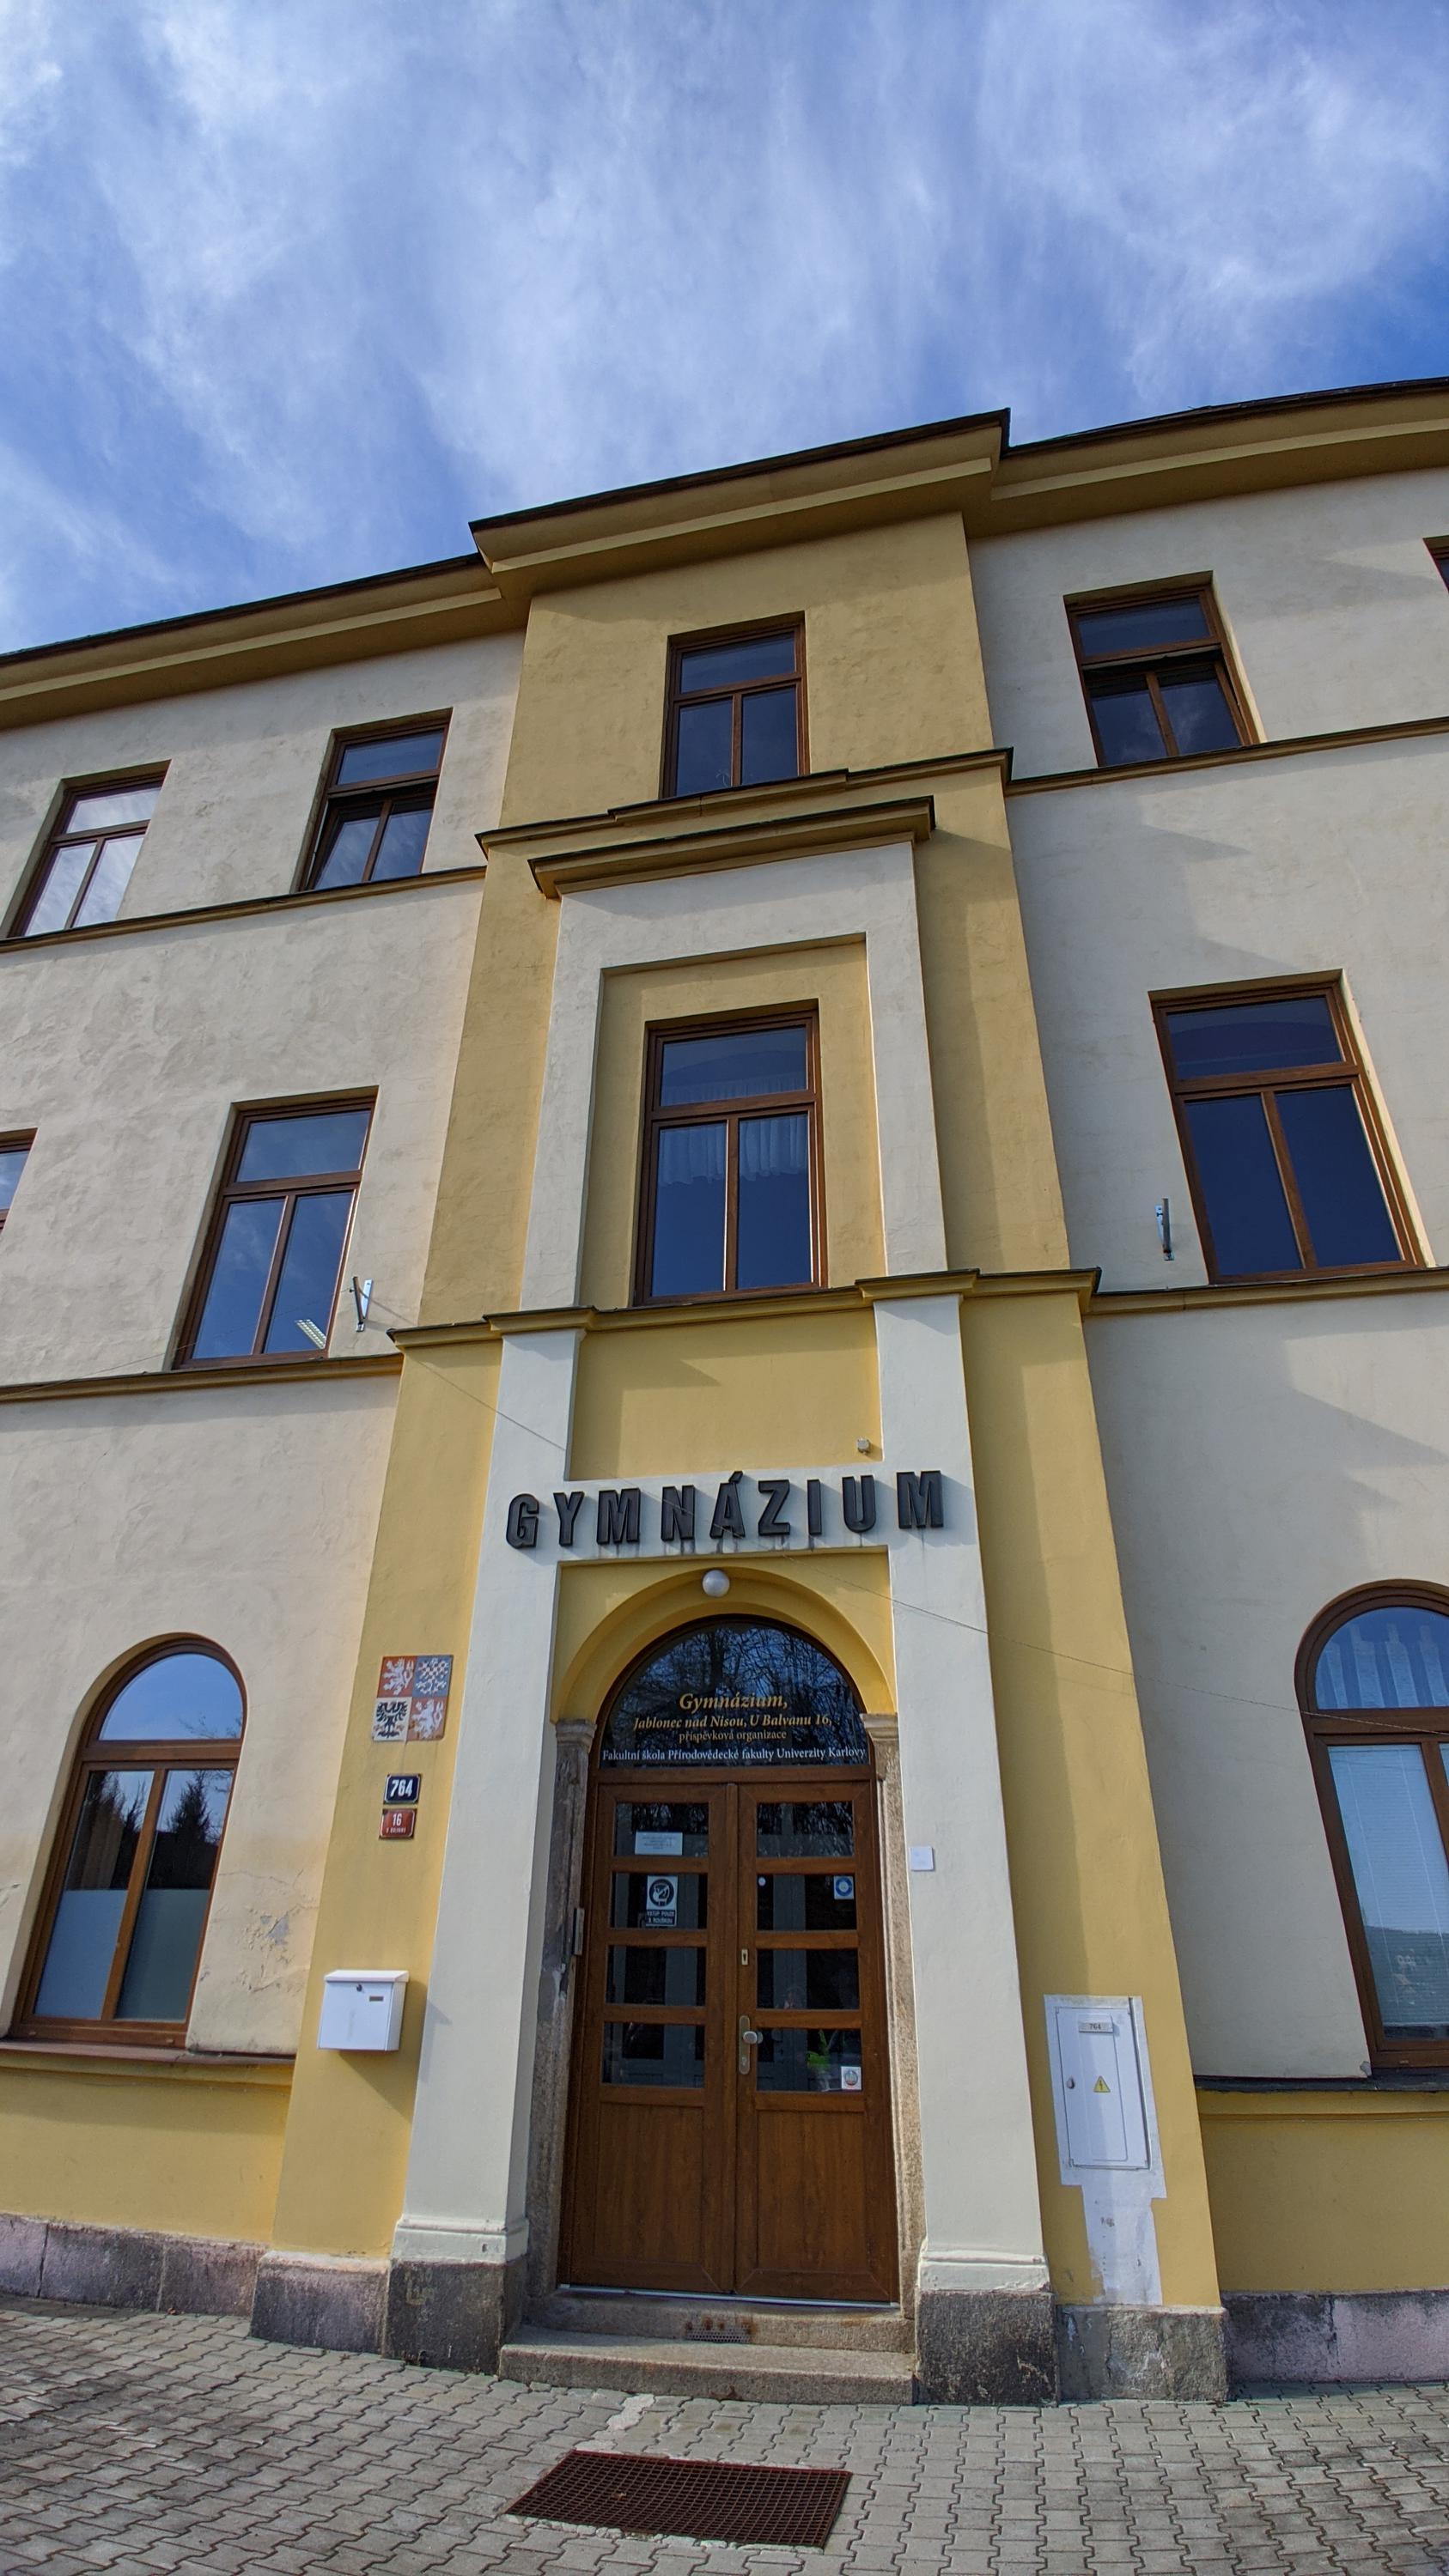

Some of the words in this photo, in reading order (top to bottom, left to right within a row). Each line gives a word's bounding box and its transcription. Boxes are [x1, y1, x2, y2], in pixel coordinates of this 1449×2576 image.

[505, 1470, 944, 1549] GYMNÁZIUM
[679, 1692, 788, 1714] Gymnázium,
[633, 1717, 682, 1731] Jablonec
[685, 1716, 707, 1728] nad
[710, 1716, 747, 1728] Nisou,
[750, 1715, 759, 1726] U
[762, 1714, 812, 1727] Balvanu
[679, 1728, 734, 1744] příspěvková
[736, 1728, 787, 1742] organizace
[602, 1746, 640, 1760] Fakultní
[642, 1746, 665, 1759] škola
[668, 1746, 739, 1759] Přírodovědecké
[742, 1748, 774, 1761] fakulty
[776, 1747, 825, 1760] Univerzity
[829, 1746, 866, 1759] Karlovy
[390, 1779, 413, 1797] 764
[393, 1813, 402, 1826] 16
